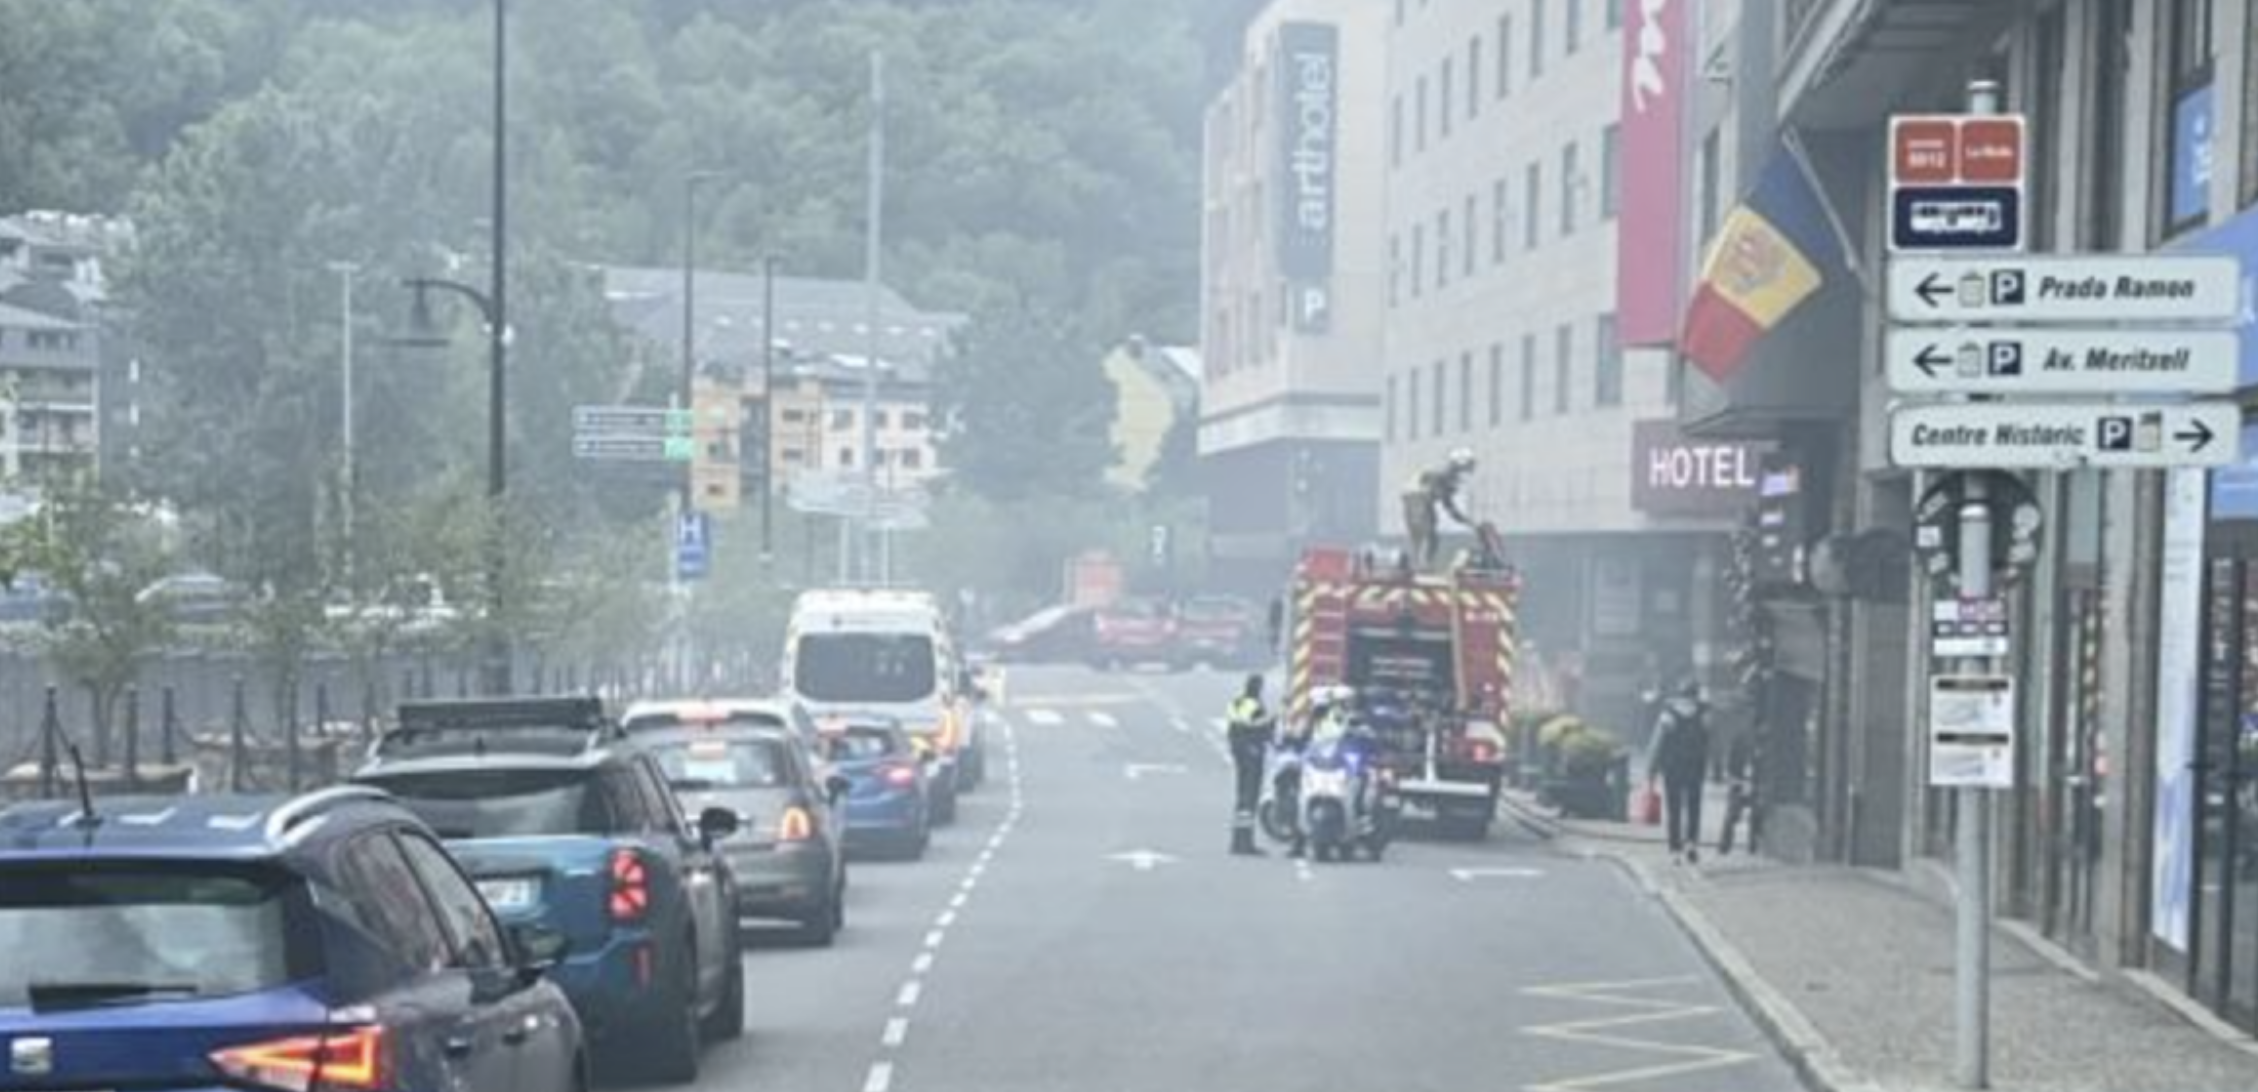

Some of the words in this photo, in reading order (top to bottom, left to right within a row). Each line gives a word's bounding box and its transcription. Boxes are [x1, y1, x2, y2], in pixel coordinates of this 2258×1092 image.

[1291, 52, 1330, 229] arthotel
[1997, 276, 2018, 300] P
[2038, 275, 2108, 299] Prada
[2113, 275, 2195, 299] Ramon
[1994, 347, 2015, 371] P
[2043, 347, 2075, 371] Av.
[1911, 423, 1988, 446] Centre
[2104, 421, 2126, 446] P
[1650, 446, 1755, 487] HOTEL
